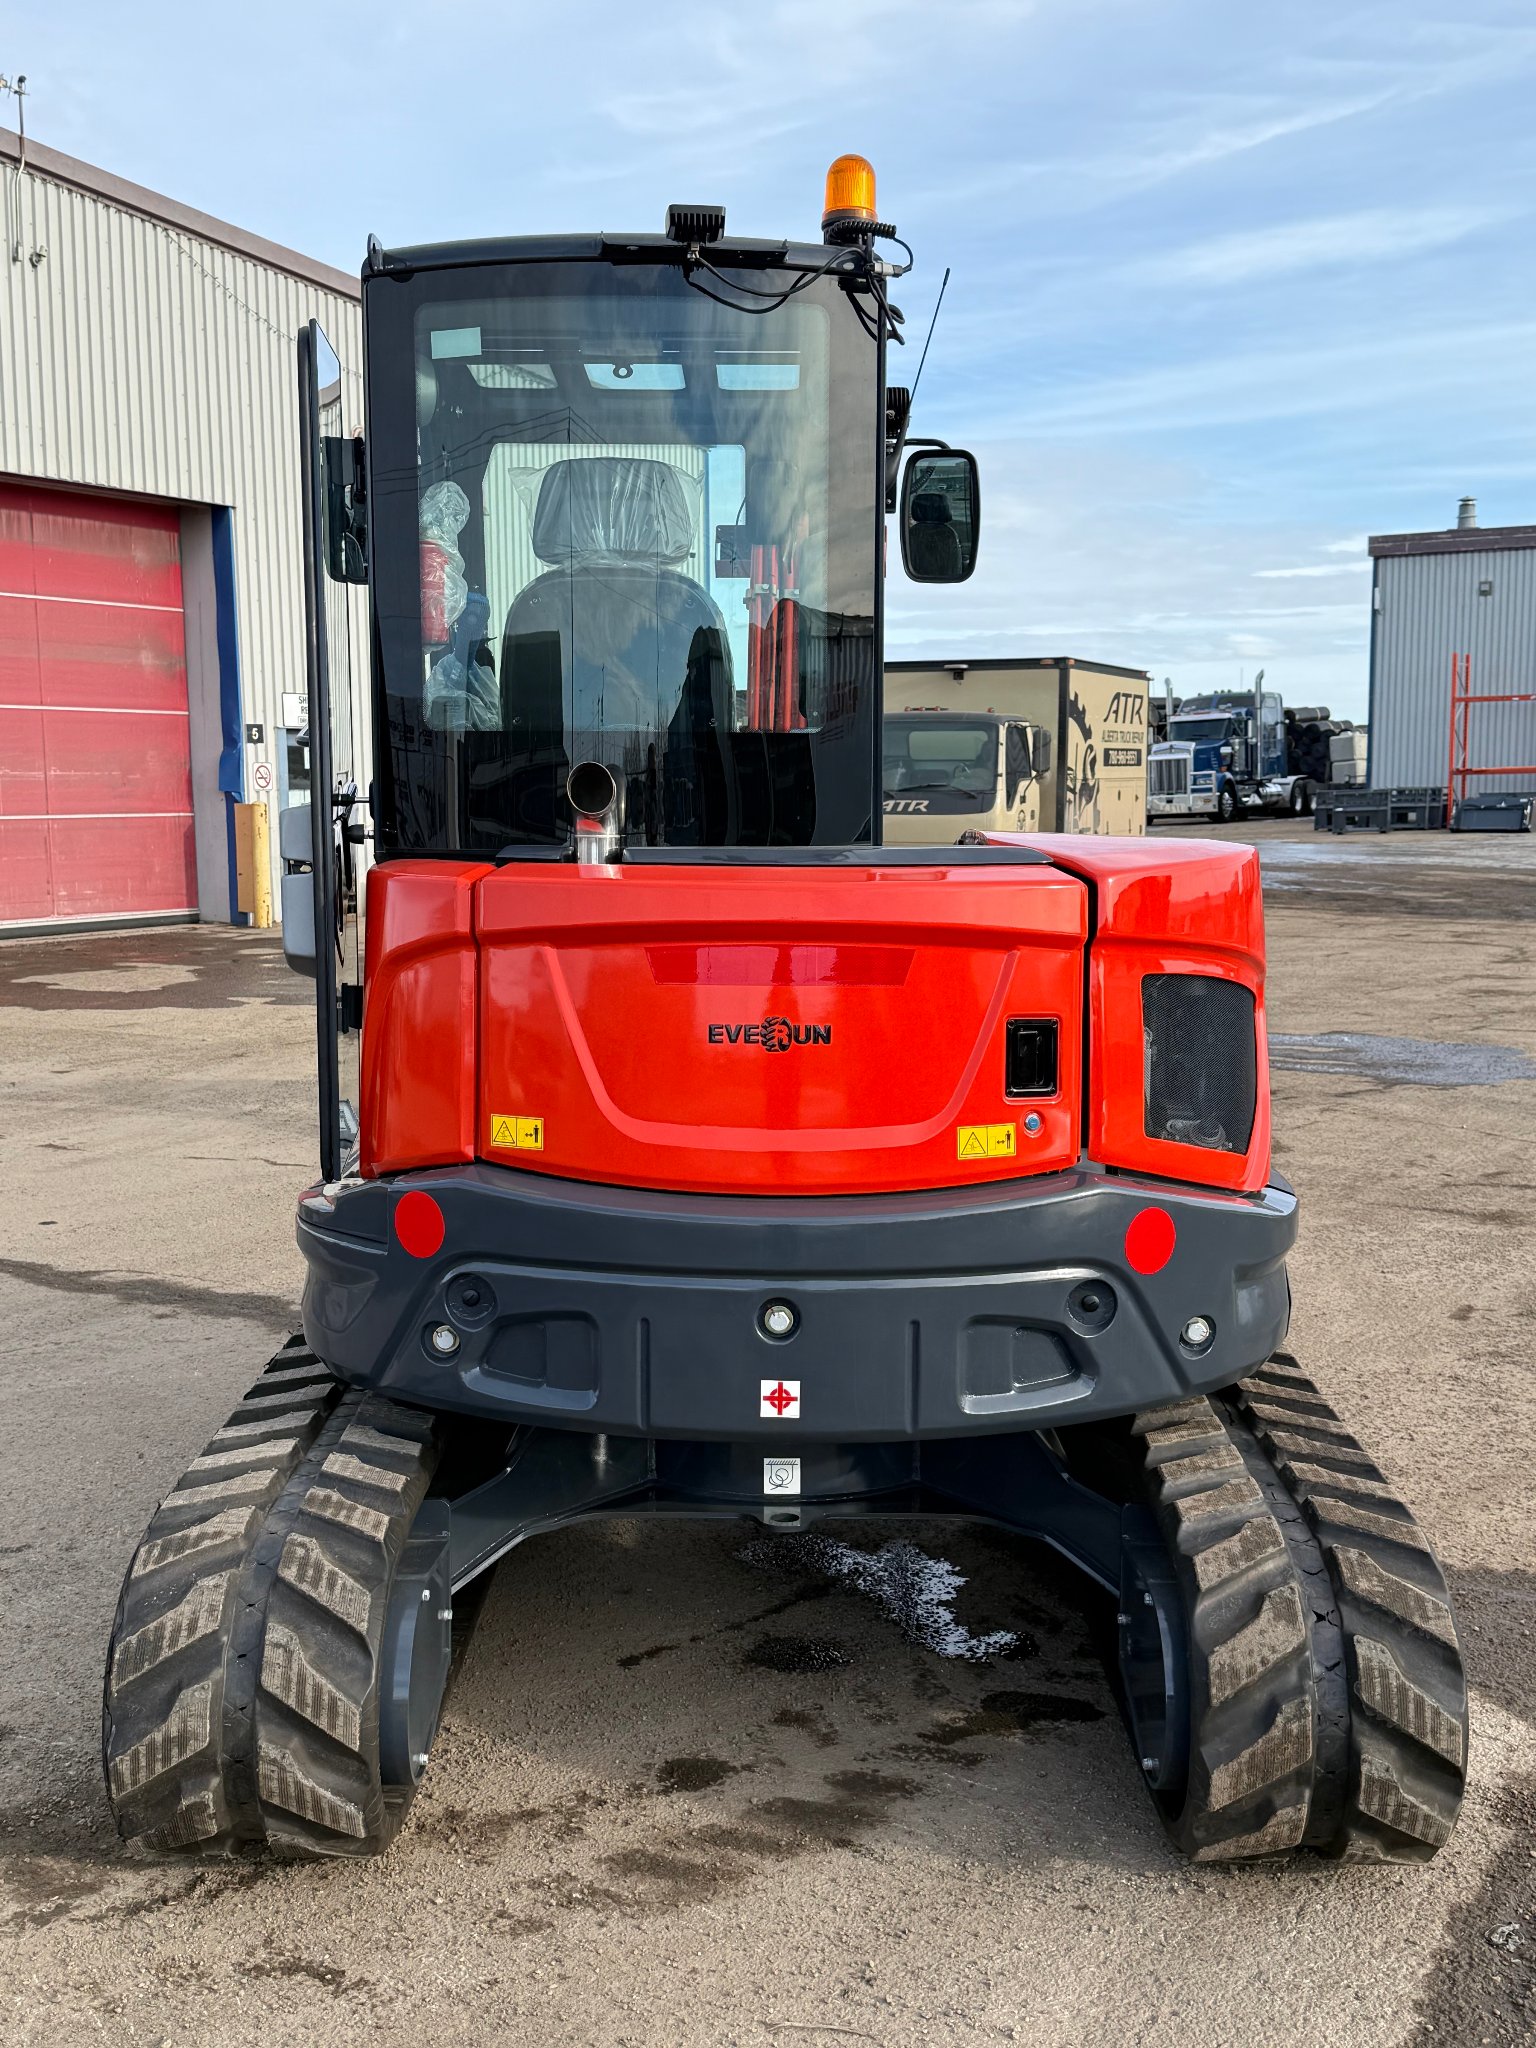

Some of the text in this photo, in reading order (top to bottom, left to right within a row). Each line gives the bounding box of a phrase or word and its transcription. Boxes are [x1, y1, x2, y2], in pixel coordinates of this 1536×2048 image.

[1103, 691, 1145, 725] ATR
[252, 728, 259, 739] 5
[883, 800, 930, 811] ATR
[708, 1016, 832, 1052] EVERUN
